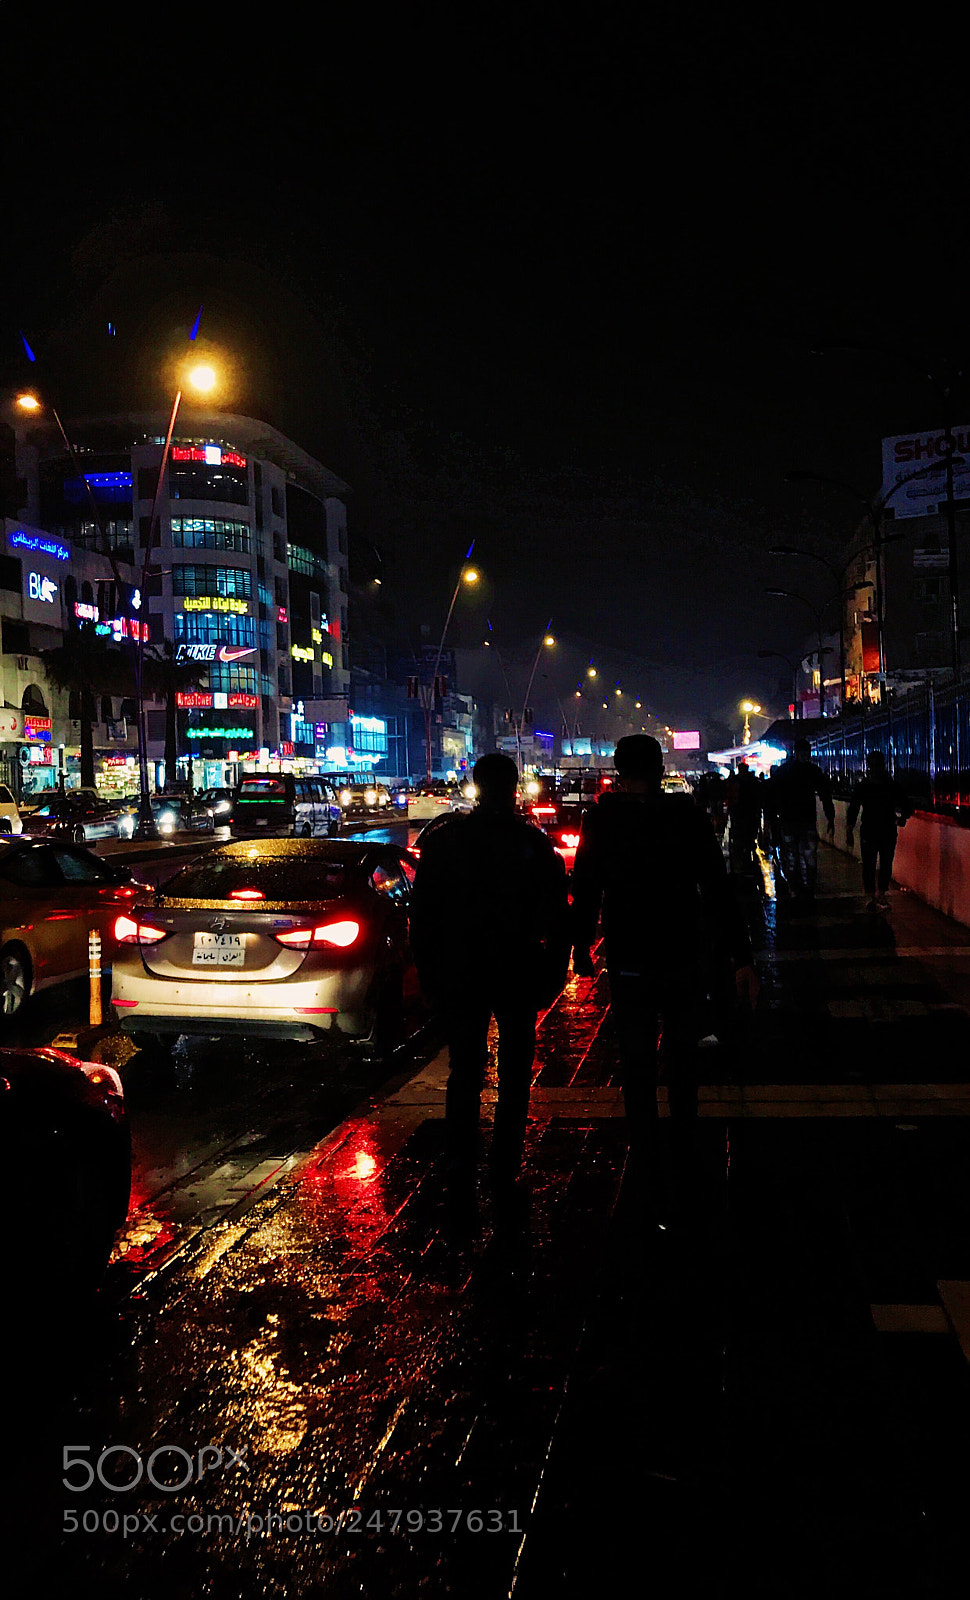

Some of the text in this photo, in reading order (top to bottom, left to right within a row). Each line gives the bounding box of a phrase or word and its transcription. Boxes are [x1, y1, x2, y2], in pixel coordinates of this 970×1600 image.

[57, 544, 69, 560] مركز
[175, 644, 217, 660] NIKE
[222, 952, 241, 962] العراق
